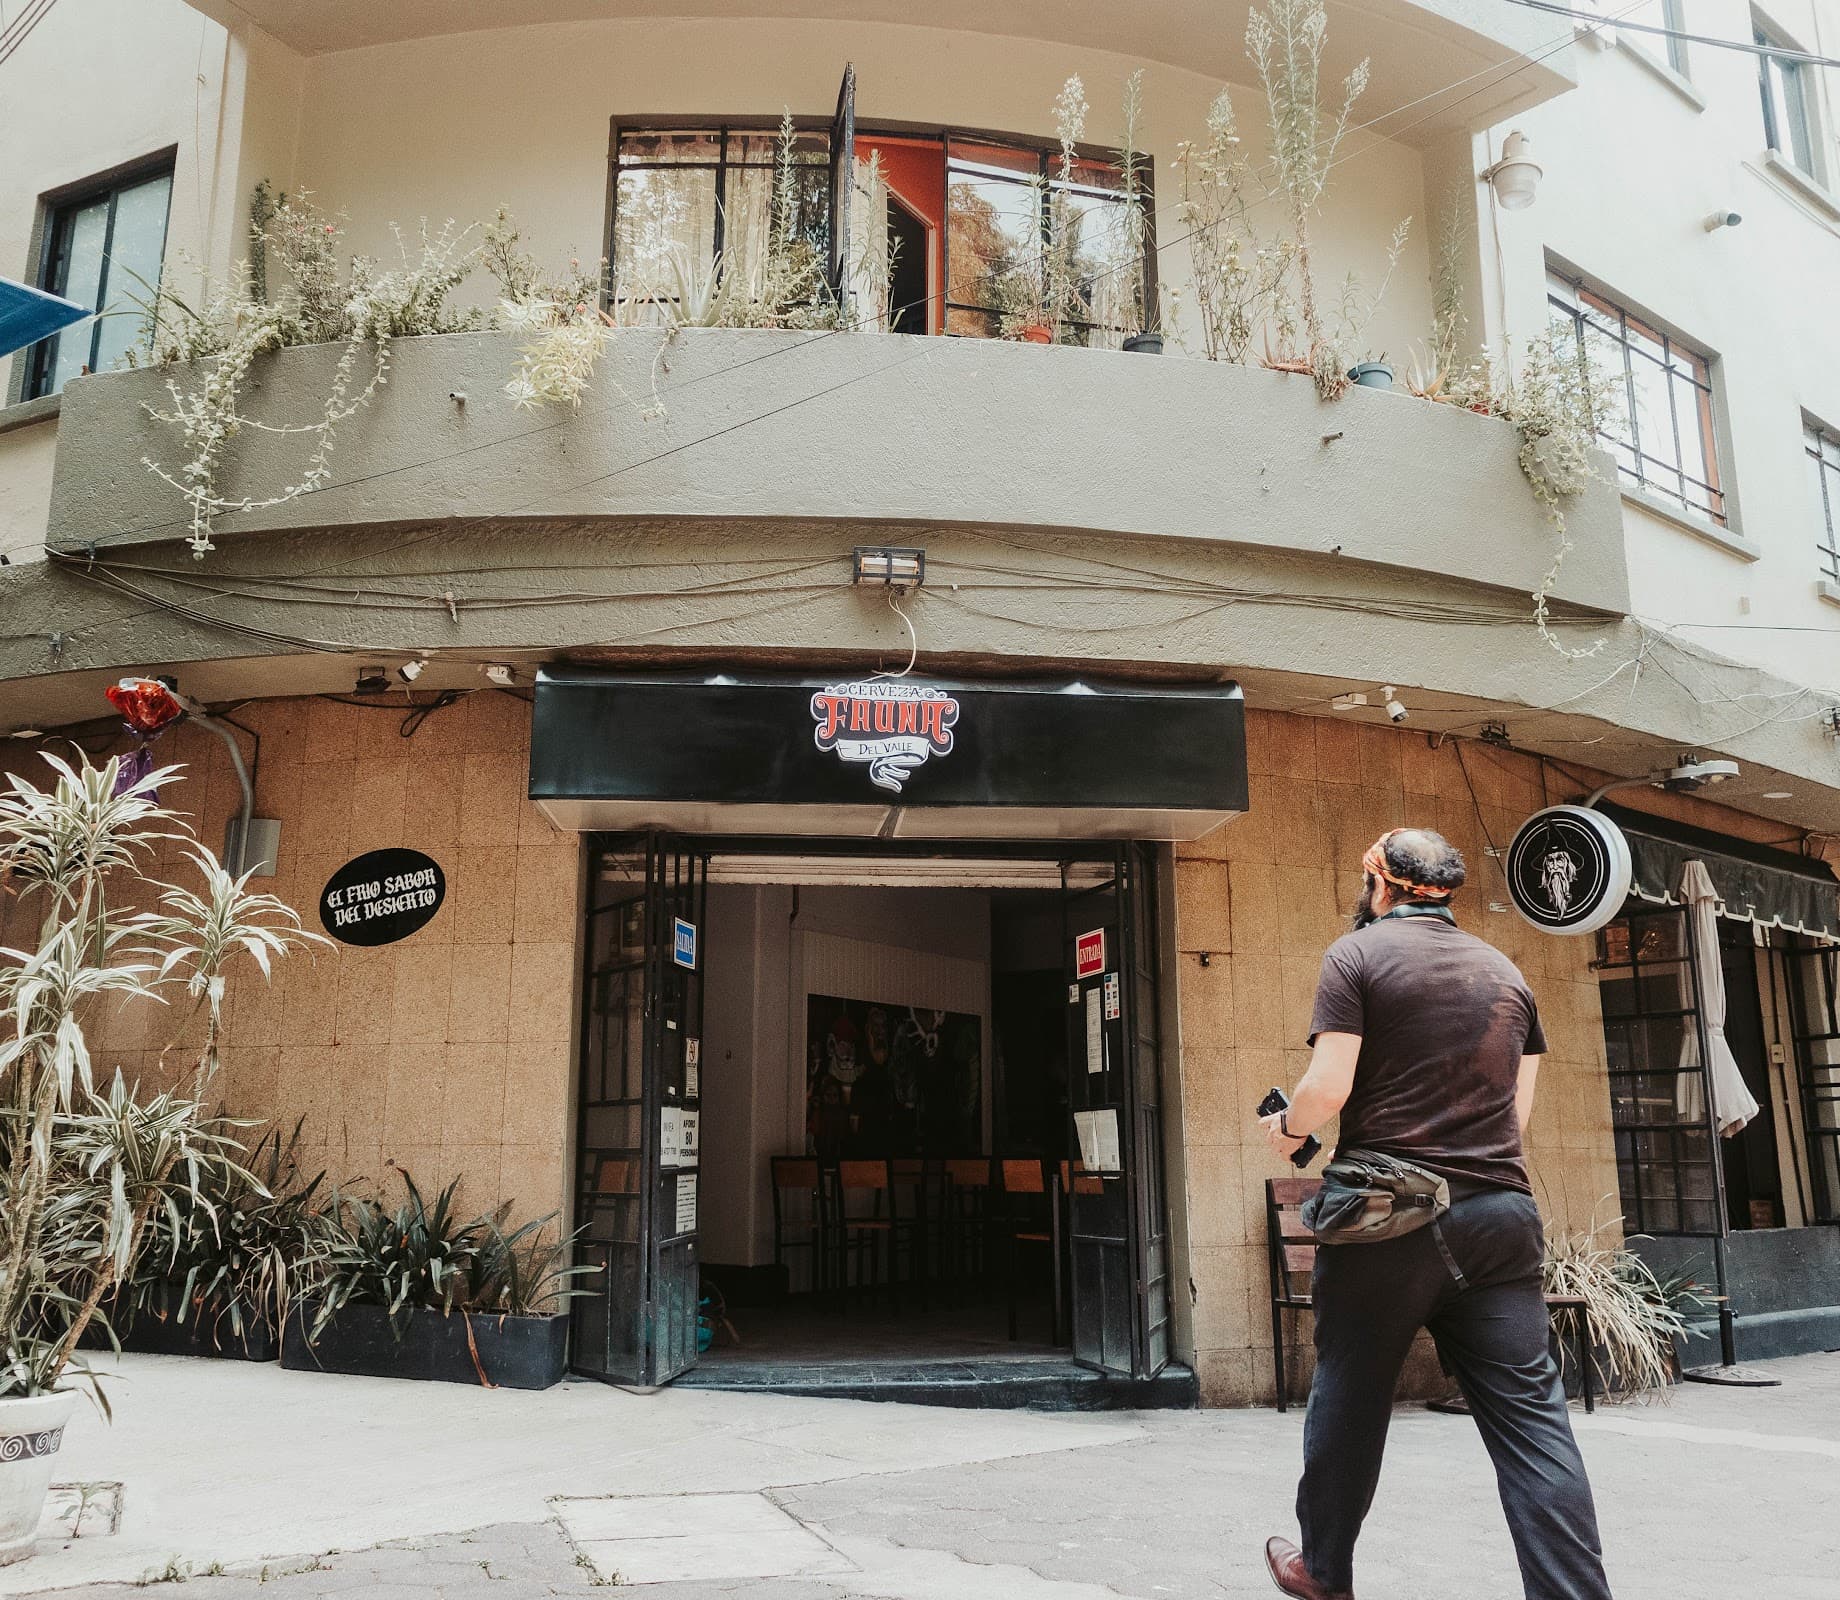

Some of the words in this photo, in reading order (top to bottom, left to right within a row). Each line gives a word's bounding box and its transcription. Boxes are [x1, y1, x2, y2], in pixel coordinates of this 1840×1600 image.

[848, 684, 922, 698] CERVEZA
[815, 694, 956, 744] FAUNA
[327, 889, 344, 909] EL
[346, 881, 381, 904] FRIO
[384, 867, 437, 895] SABOR
[334, 905, 362, 927] DEL
[363, 888, 437, 920] DESIERTO
